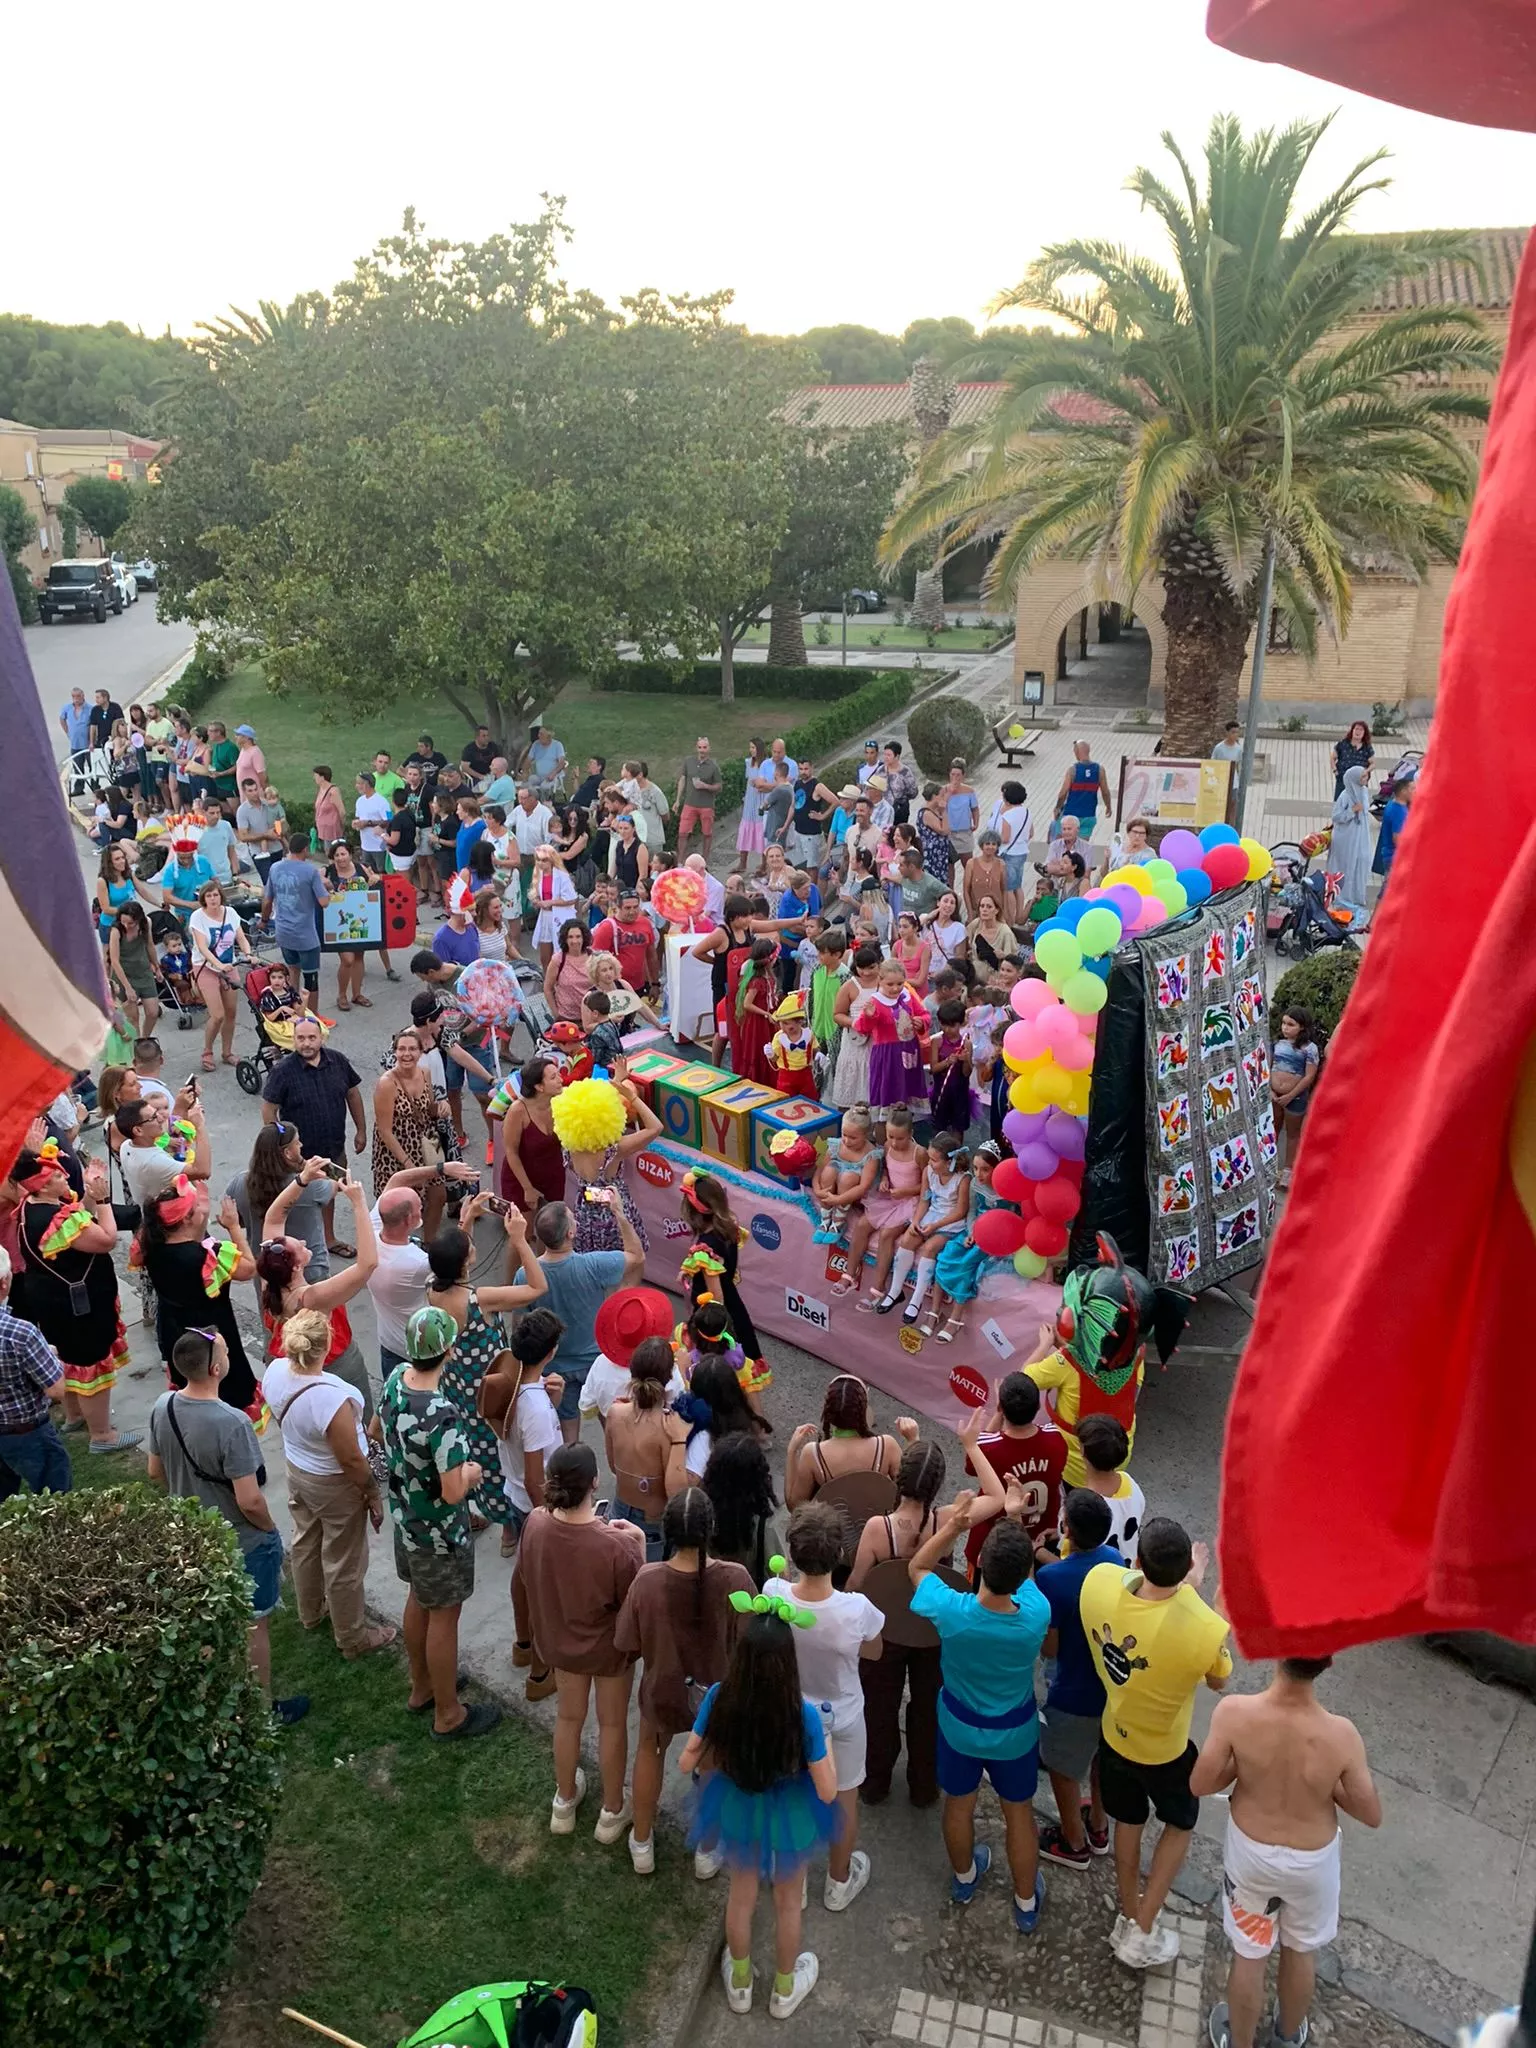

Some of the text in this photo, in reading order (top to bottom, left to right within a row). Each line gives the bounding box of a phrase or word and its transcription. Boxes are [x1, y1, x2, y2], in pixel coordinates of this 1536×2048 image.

[638, 1157, 672, 1182] BIZAK
[662, 1217, 690, 1237] Barb
[787, 1295, 827, 1327] Diset
[949, 1369, 988, 1403] MATTEL
[1012, 1457, 1049, 1478] IVÁN
